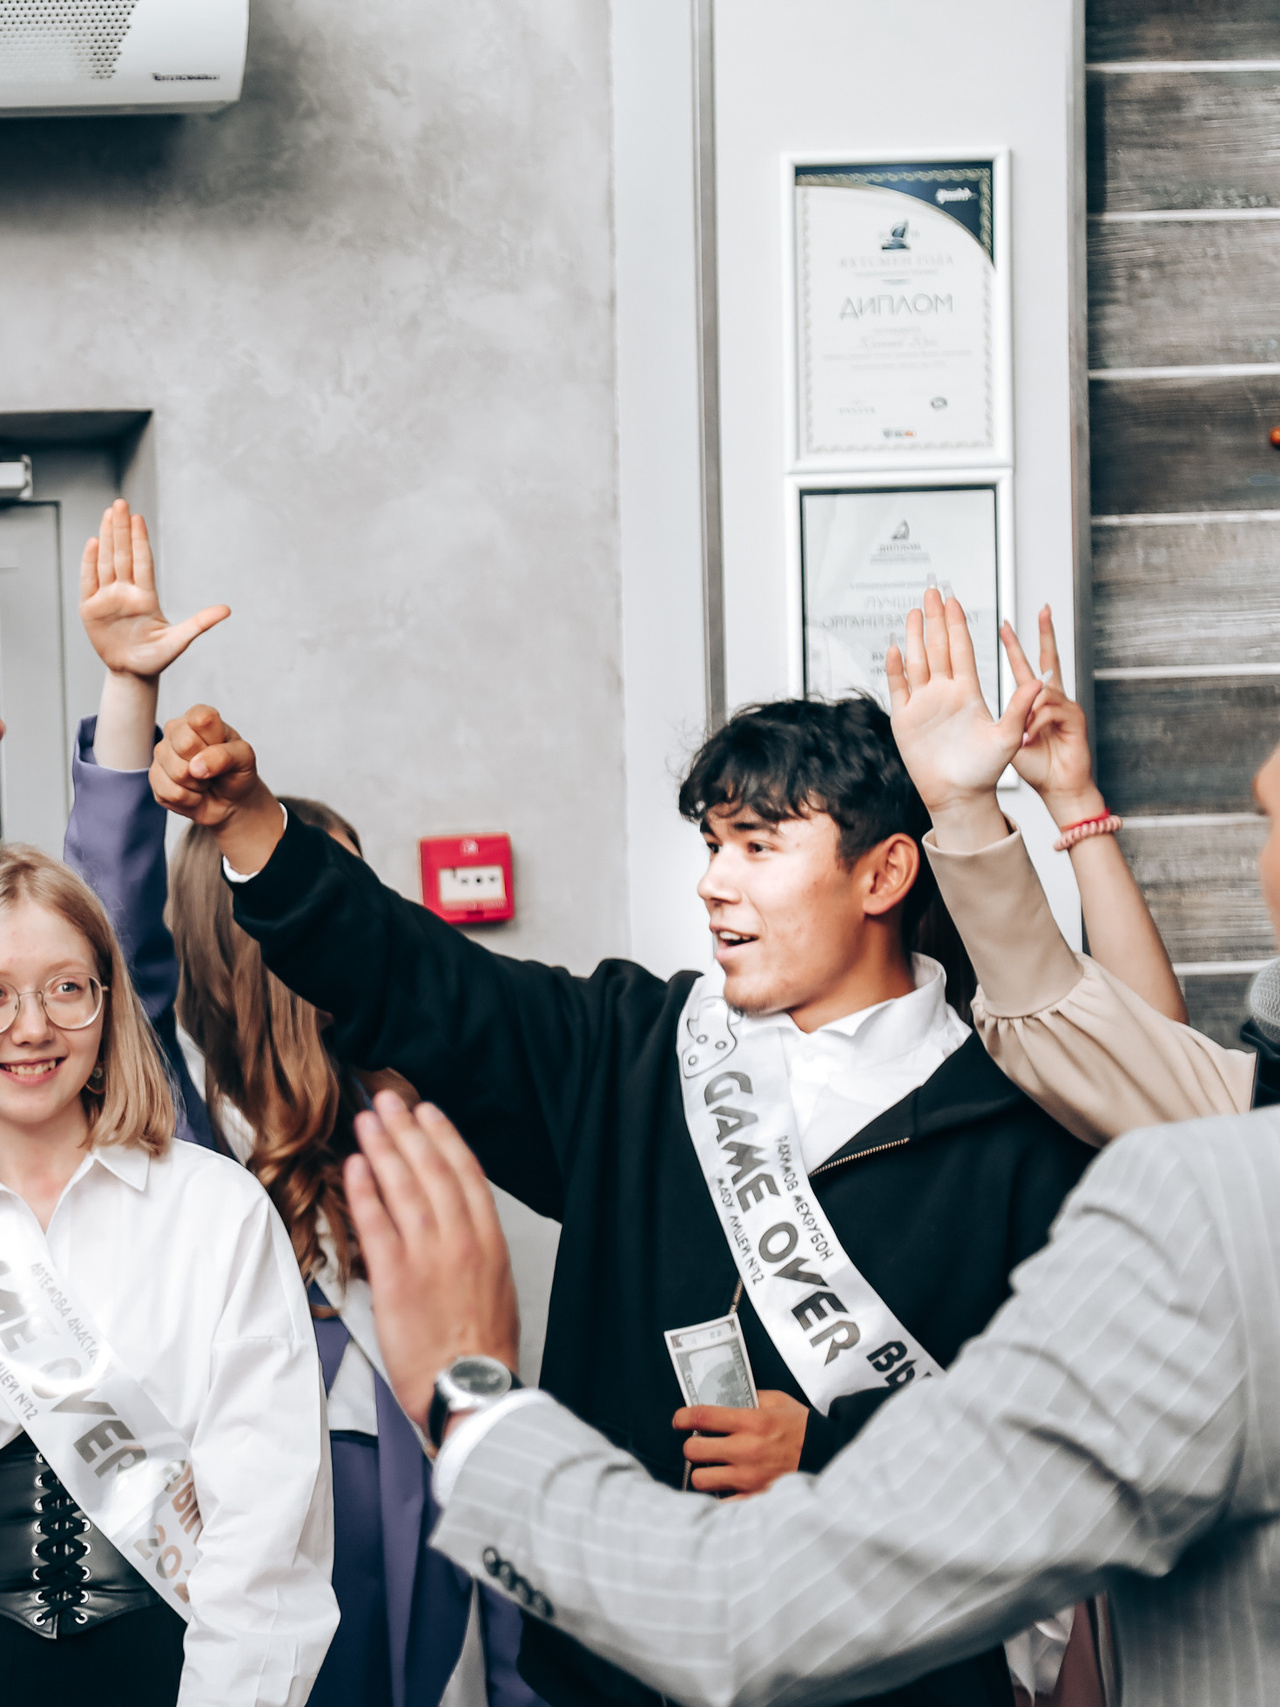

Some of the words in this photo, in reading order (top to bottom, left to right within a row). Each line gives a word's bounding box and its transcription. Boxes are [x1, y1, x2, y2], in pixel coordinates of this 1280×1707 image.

[839, 293, 954, 320] ДИПЛОМ
[704, 1071, 782, 1213] GAME
[758, 1221, 860, 1366] OVER
[716, 1177, 735, 1208] МАОУ
[729, 1215, 751, 1256] ЛИЦЕЙ
[793, 1195, 834, 1262] МЕХРУБОН
[14, 1391, 39, 1421] №12
[32, 1357, 148, 1479] OVER
